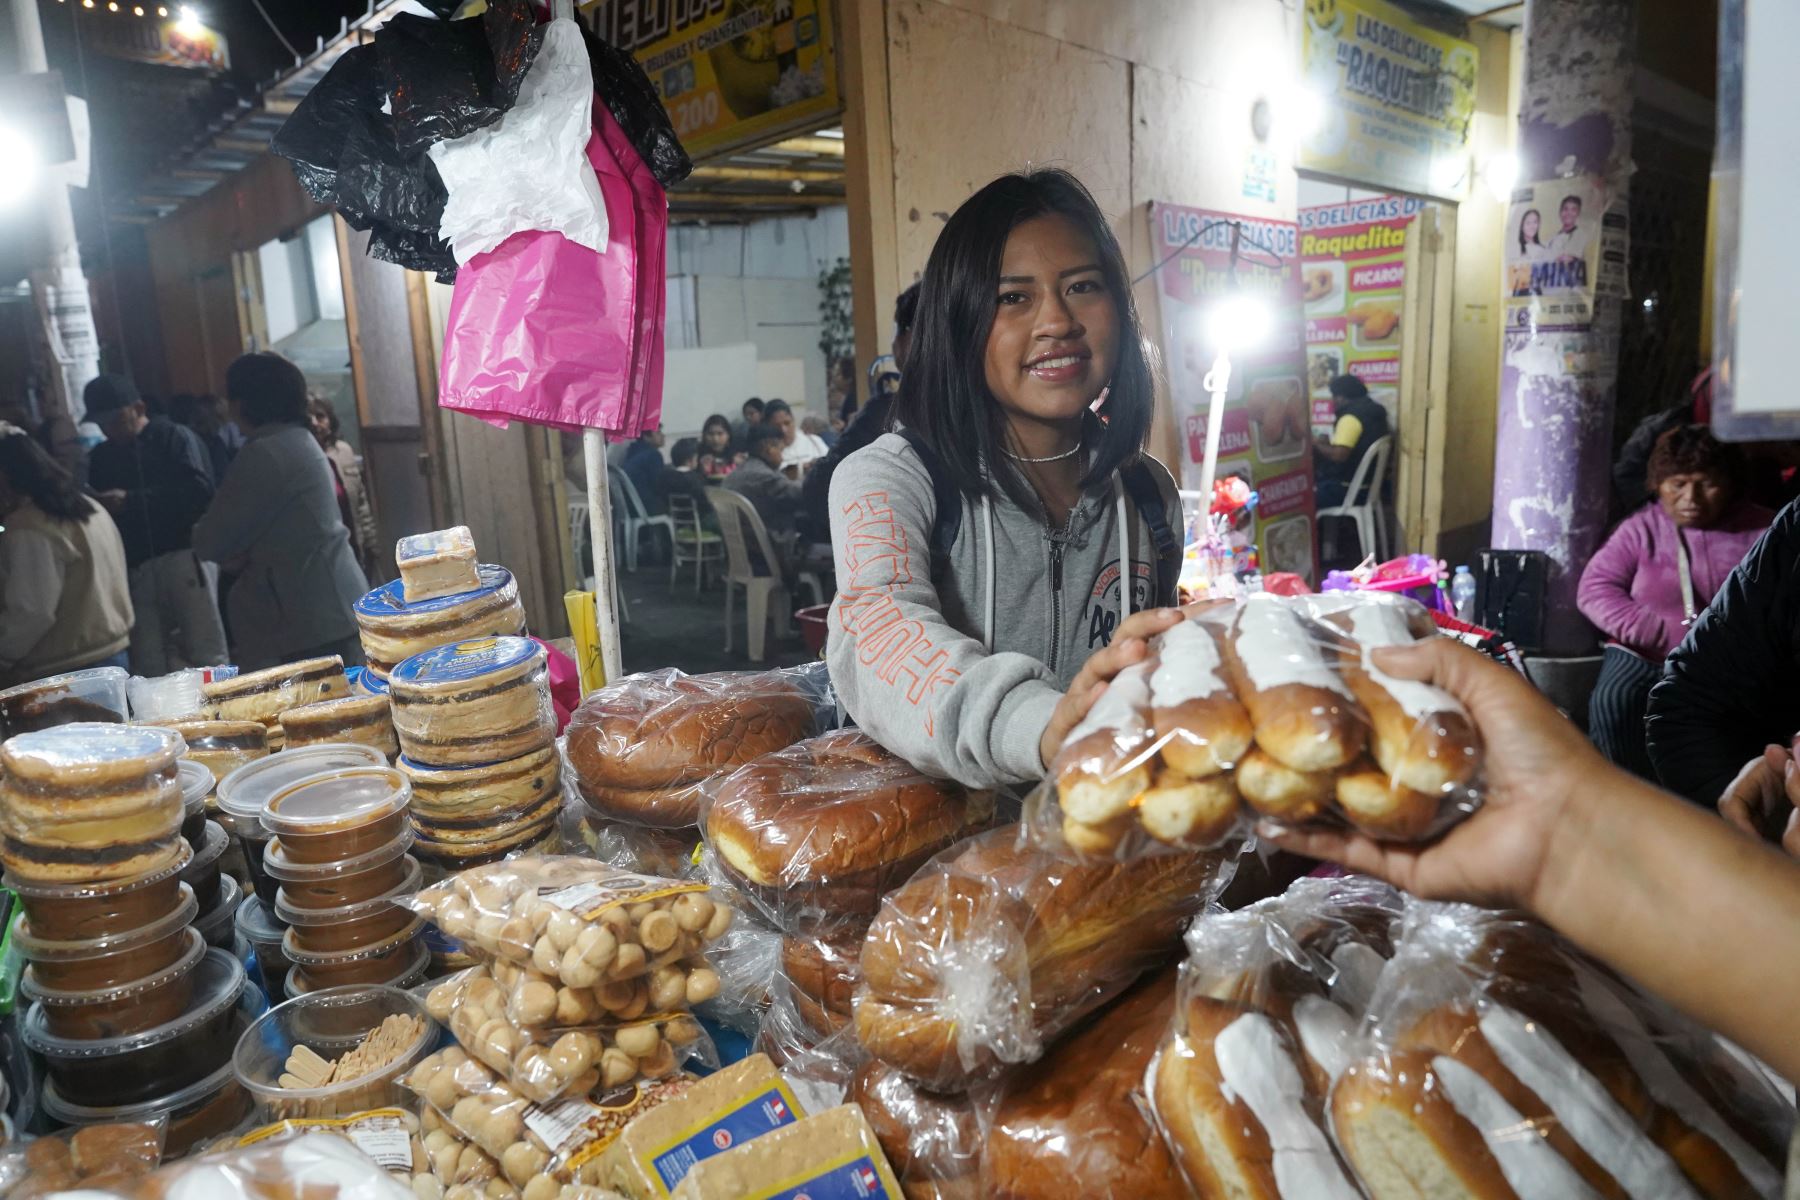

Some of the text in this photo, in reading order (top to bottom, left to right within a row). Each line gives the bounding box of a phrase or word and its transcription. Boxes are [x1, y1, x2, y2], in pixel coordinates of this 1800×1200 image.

[1356, 14, 1381, 43] LAS
[1318, 202, 1399, 227] DELICIAS
[1165, 213, 1198, 245] LAS
[1277, 227, 1296, 254] DE
